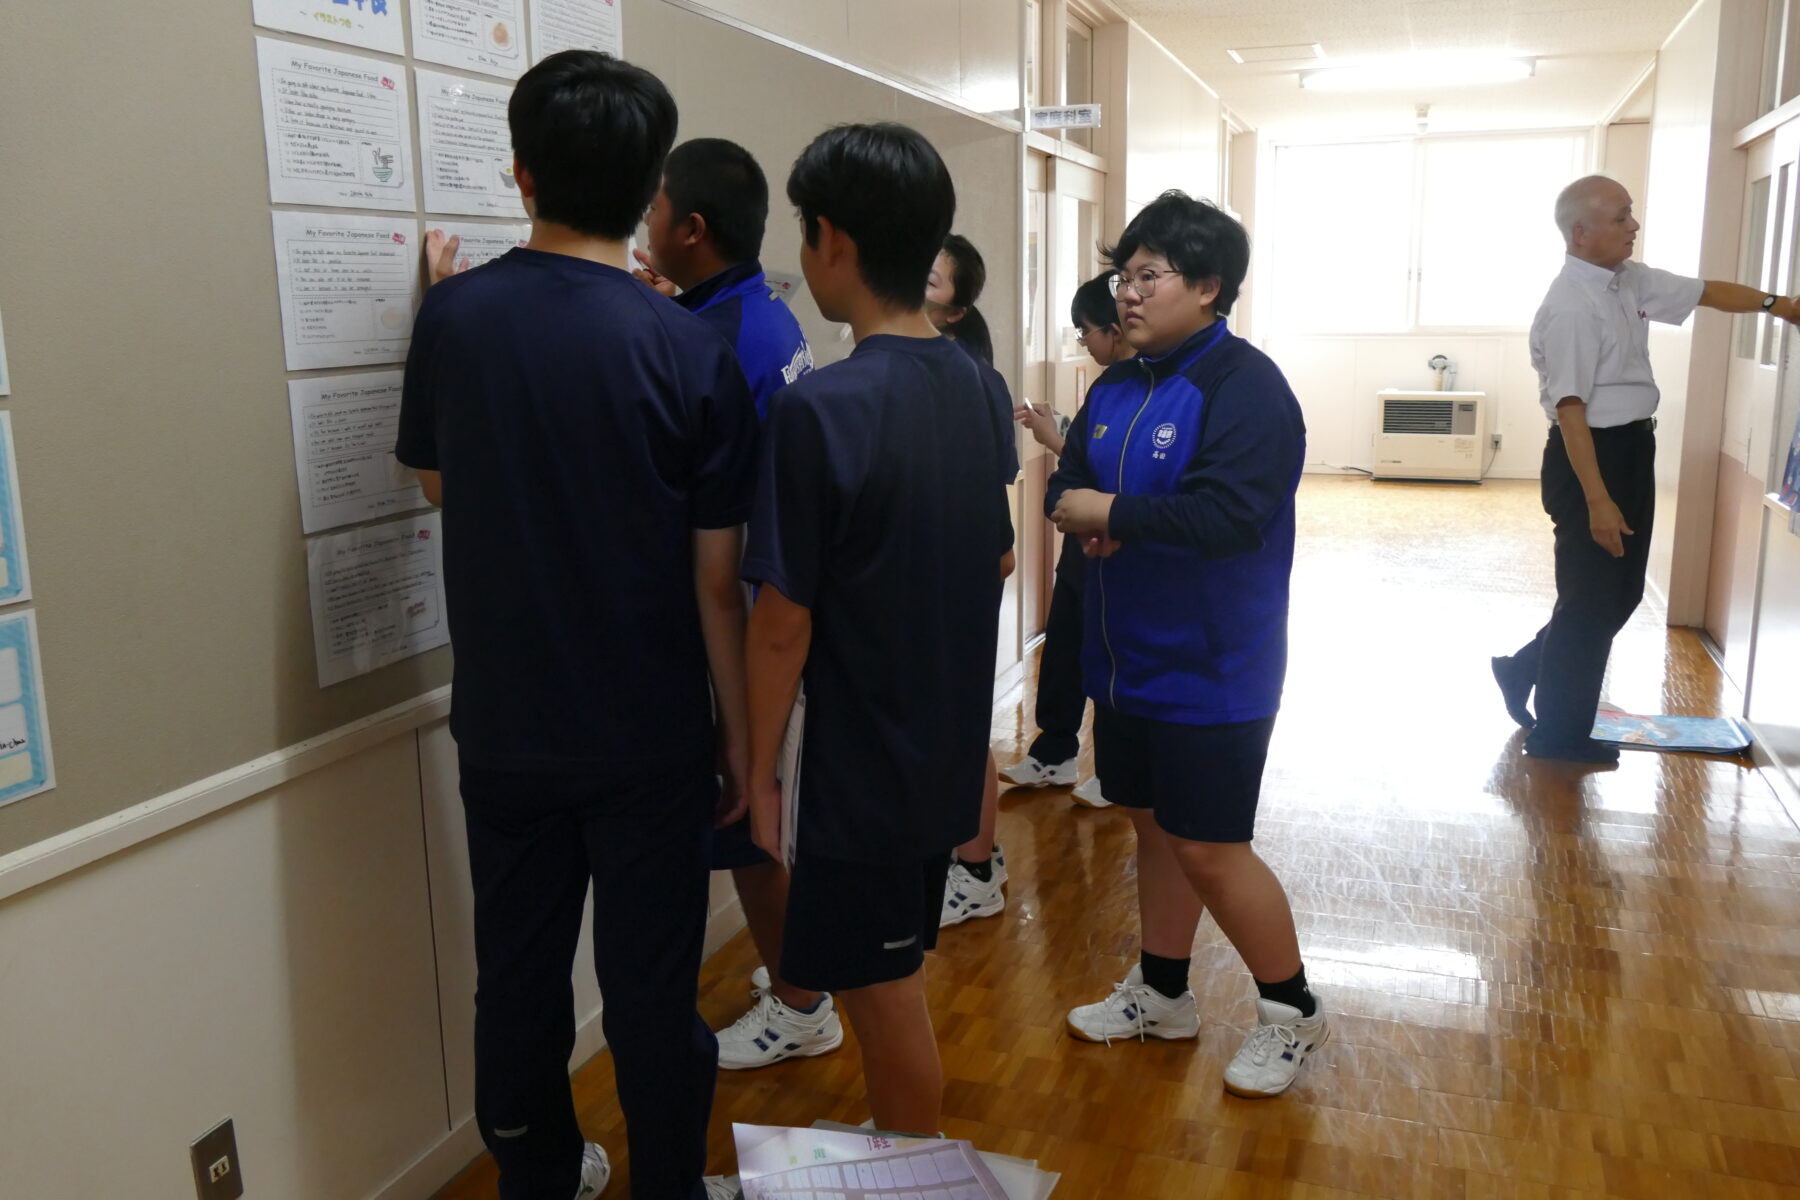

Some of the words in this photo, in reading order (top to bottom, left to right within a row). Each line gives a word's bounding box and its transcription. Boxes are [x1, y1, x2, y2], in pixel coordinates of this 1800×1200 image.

[291, 60, 302, 69] My
[303, 62, 332, 74] Favorite
[333, 68, 362, 79] Japanese
[363, 73, 379, 82] Food
[1034, 108, 1093, 126] 家庭科室
[305, 229, 316, 237] My
[317, 229, 345, 238] Favorite
[346, 230, 375, 239] Japanese
[482, 237, 504, 245] Japanese
[332, 390, 359, 399] Favorite
[360, 388, 388, 397] Japanese
